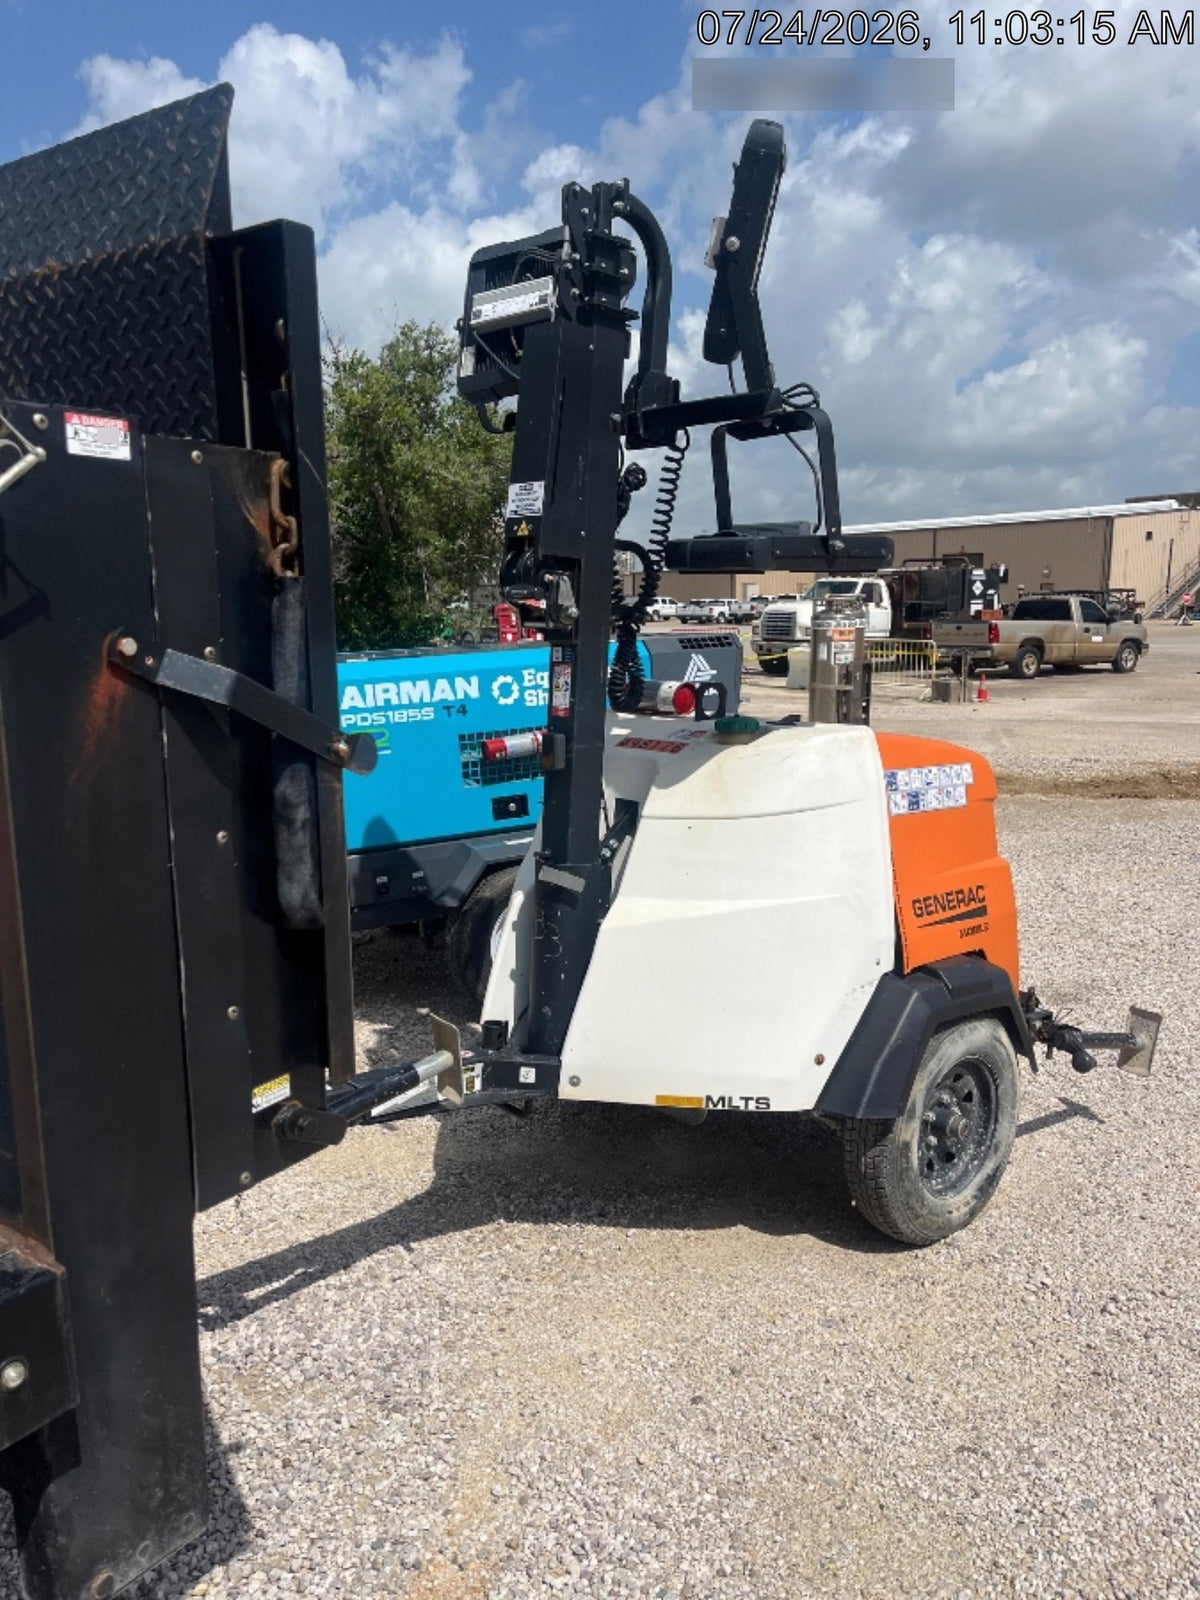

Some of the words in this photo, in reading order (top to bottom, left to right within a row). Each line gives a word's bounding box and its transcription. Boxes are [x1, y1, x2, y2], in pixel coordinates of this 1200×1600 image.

[340, 676, 480, 709] AIRMAN
[341, 706, 435, 728] PDS185S
[912, 885, 986, 918] GENERAC
[705, 1094, 771, 1111] MLTS
